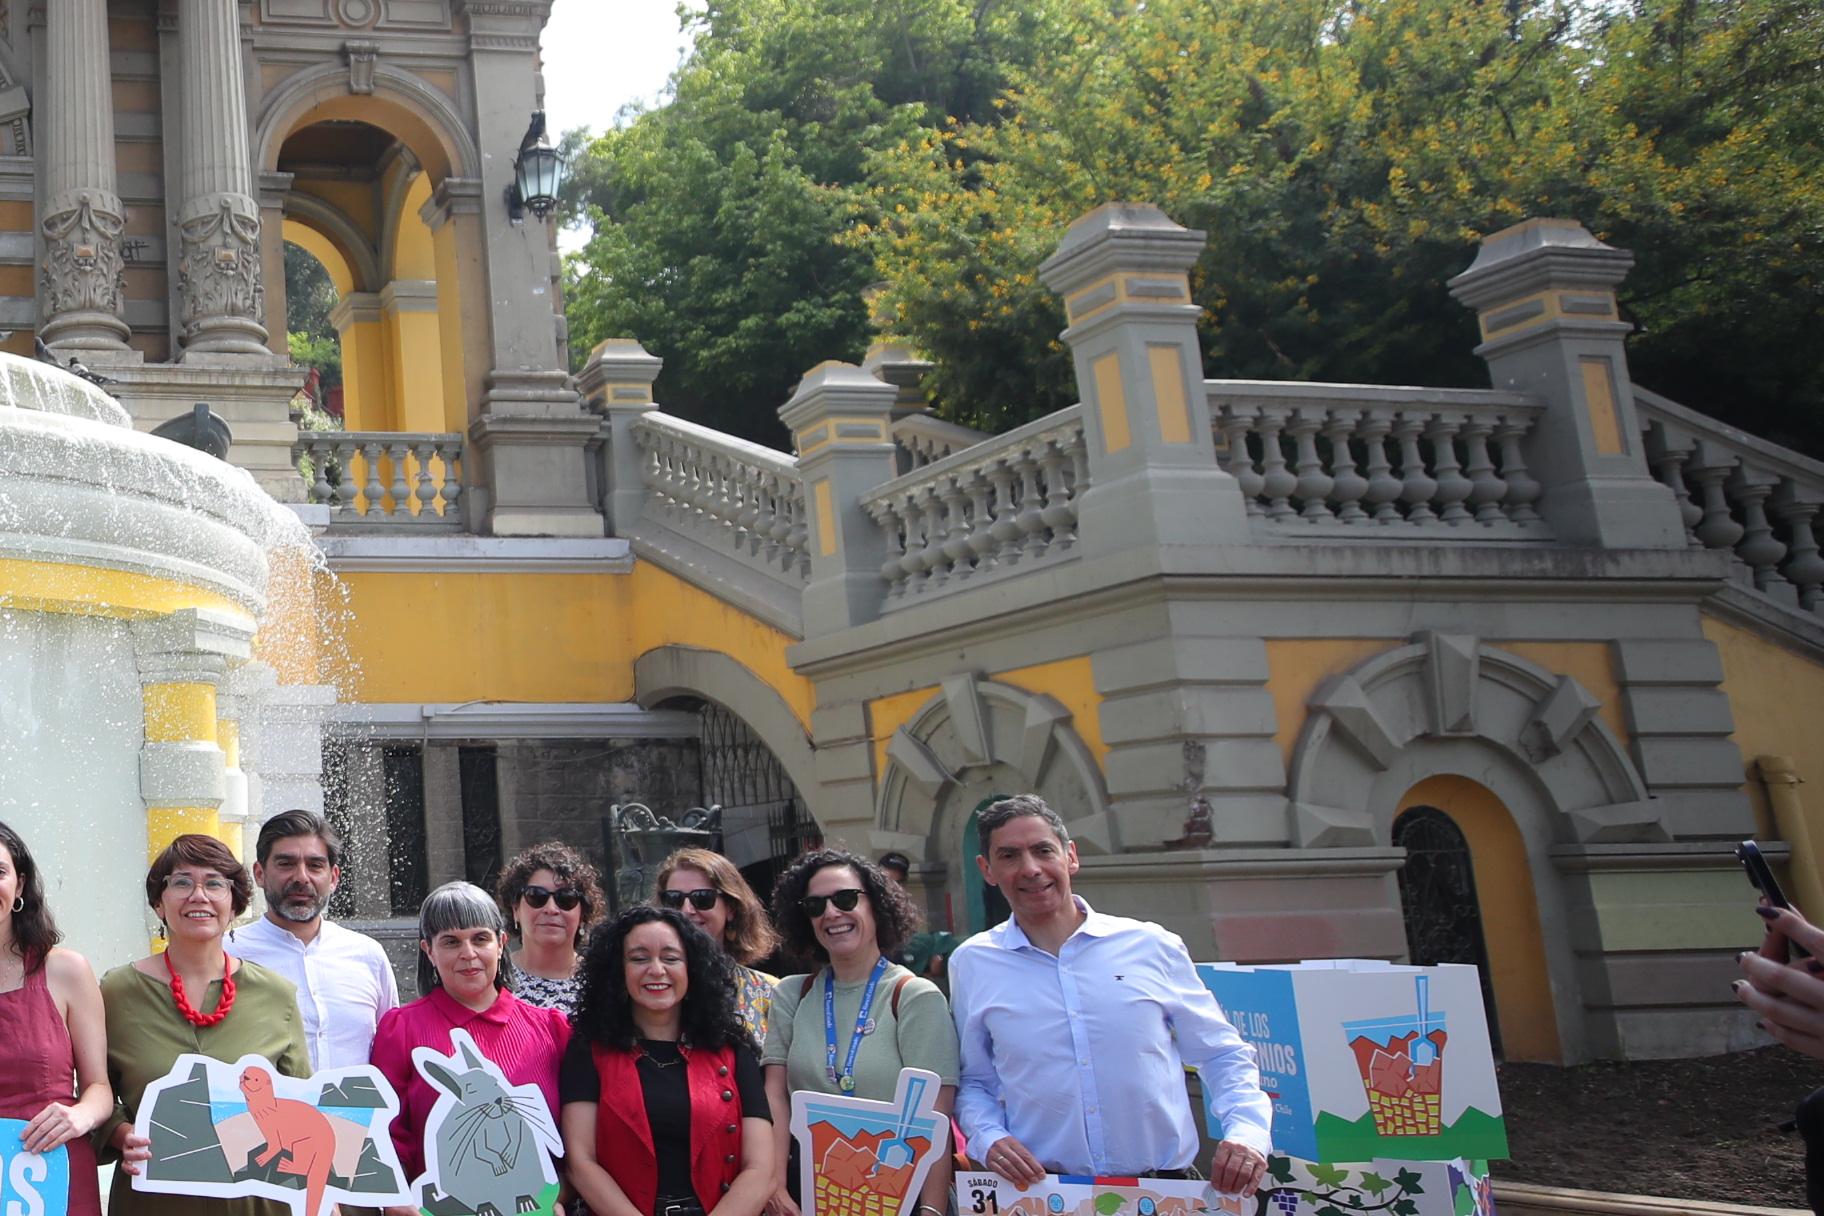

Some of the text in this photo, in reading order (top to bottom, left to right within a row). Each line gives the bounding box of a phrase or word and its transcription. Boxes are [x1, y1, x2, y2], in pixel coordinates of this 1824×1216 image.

[1233, 1010, 1249, 1036] DE
[1249, 1012, 1271, 1039] LOS
[968, 1177, 998, 1188] SÁBADO
[972, 1189, 998, 1214] 31
